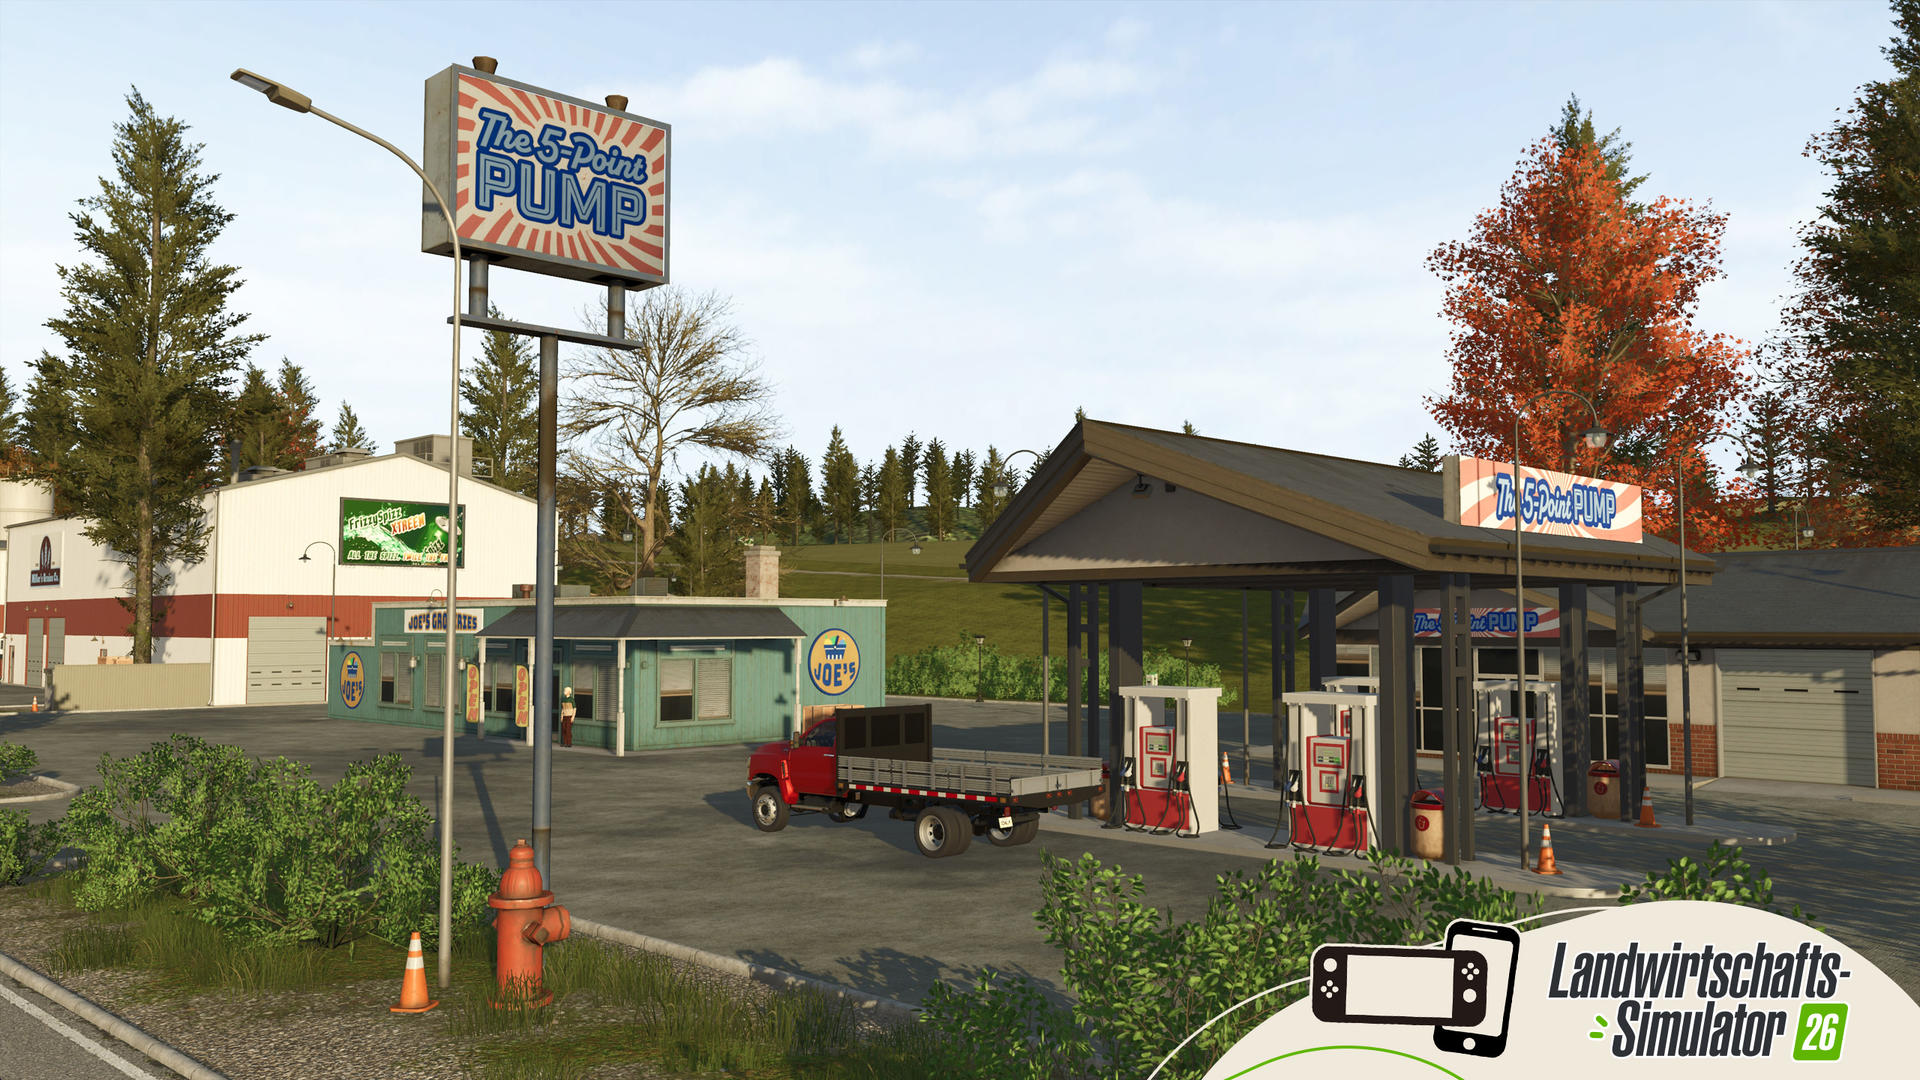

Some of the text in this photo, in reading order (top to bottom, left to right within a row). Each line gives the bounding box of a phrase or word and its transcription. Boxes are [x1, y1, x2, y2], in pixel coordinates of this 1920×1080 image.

[477, 108, 648, 184] The 5-Point
[476, 150, 647, 239] PUMP
[1497, 474, 1616, 528] Th 5-Point PUMP
[408, 611, 477, 630] JOE'S GRORIES
[1414, 613, 1437, 633] The
[342, 680, 362, 701] JOE'S
[468, 666, 479, 721] OPEN
[517, 667, 528, 725] OPEN
[814, 661, 856, 687] JOE'S
